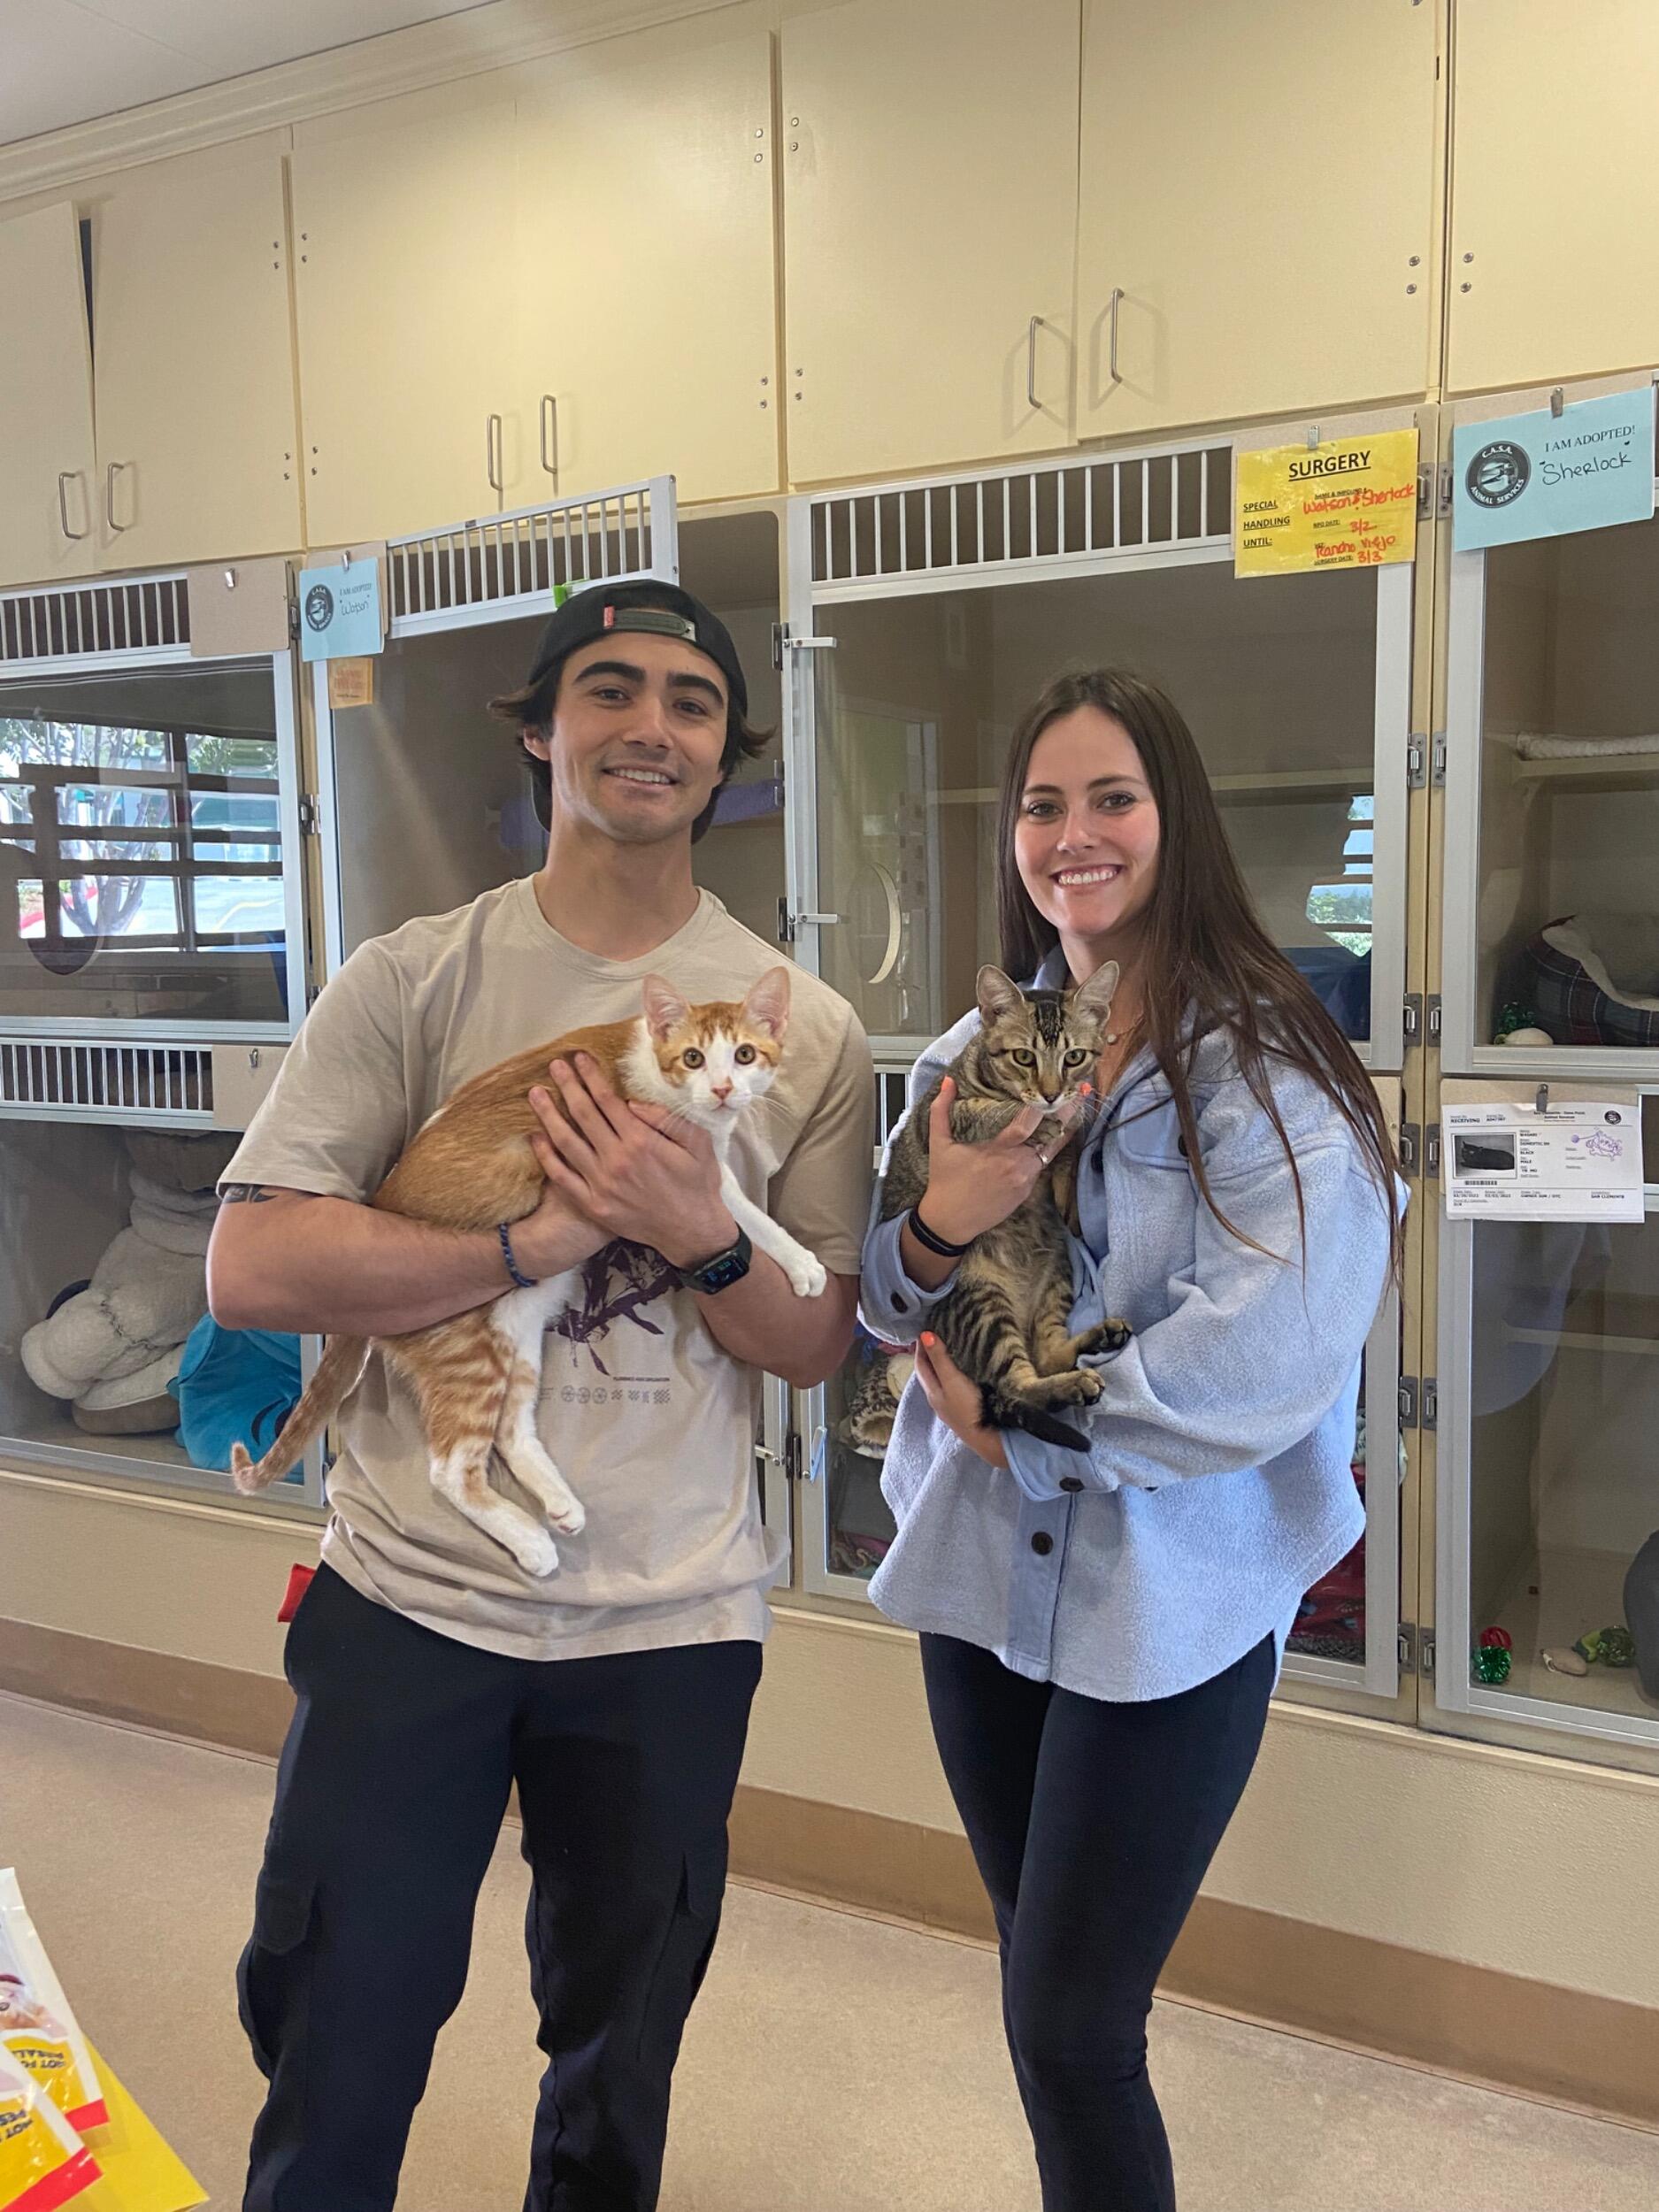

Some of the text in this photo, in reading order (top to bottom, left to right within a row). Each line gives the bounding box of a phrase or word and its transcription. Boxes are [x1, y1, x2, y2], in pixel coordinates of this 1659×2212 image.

[1552, 439, 1571, 451] AM
[1574, 426, 1635, 446] ADOPTED!
[1288, 450, 1371, 480] SURGERY
[1303, 494, 1351, 515] Watson
[1361, 483, 1416, 508] Sherlock
[1470, 478, 1525, 504] ANIMAL SERVICES
[1243, 500, 1278, 511] SPECIAL
[1243, 516, 1290, 530] HANDLING
[1243, 537, 1272, 548] UNTIL:
[1316, 541, 1356, 558] Rancho
